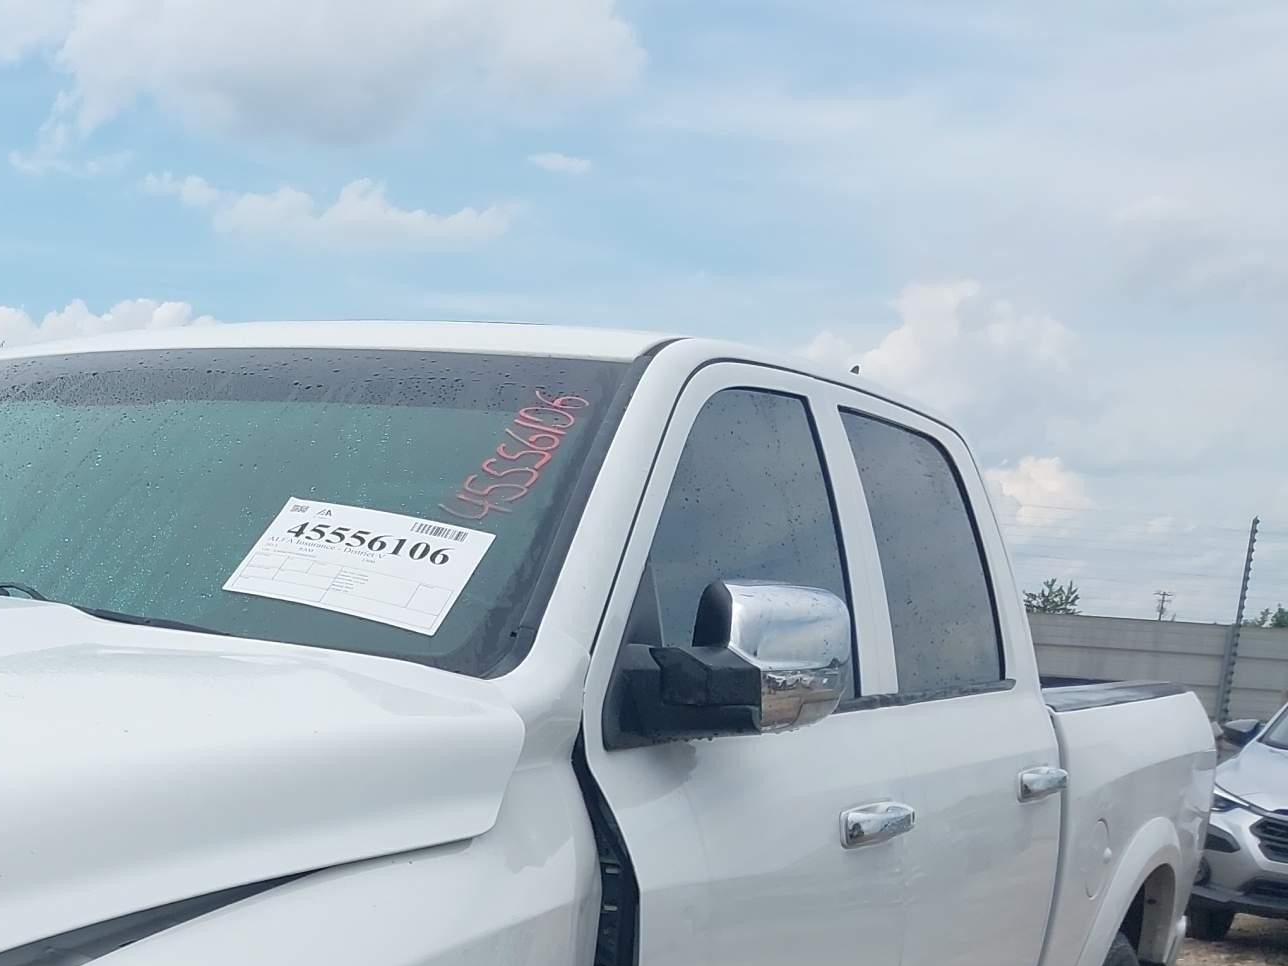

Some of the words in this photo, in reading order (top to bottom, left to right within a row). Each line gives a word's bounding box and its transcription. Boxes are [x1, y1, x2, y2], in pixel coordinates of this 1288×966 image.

[438, 390, 590, 519] 45556106
[287, 521, 455, 566] 45556106
[296, 539, 336, 551] Insurance
[344, 547, 374, 559] District
